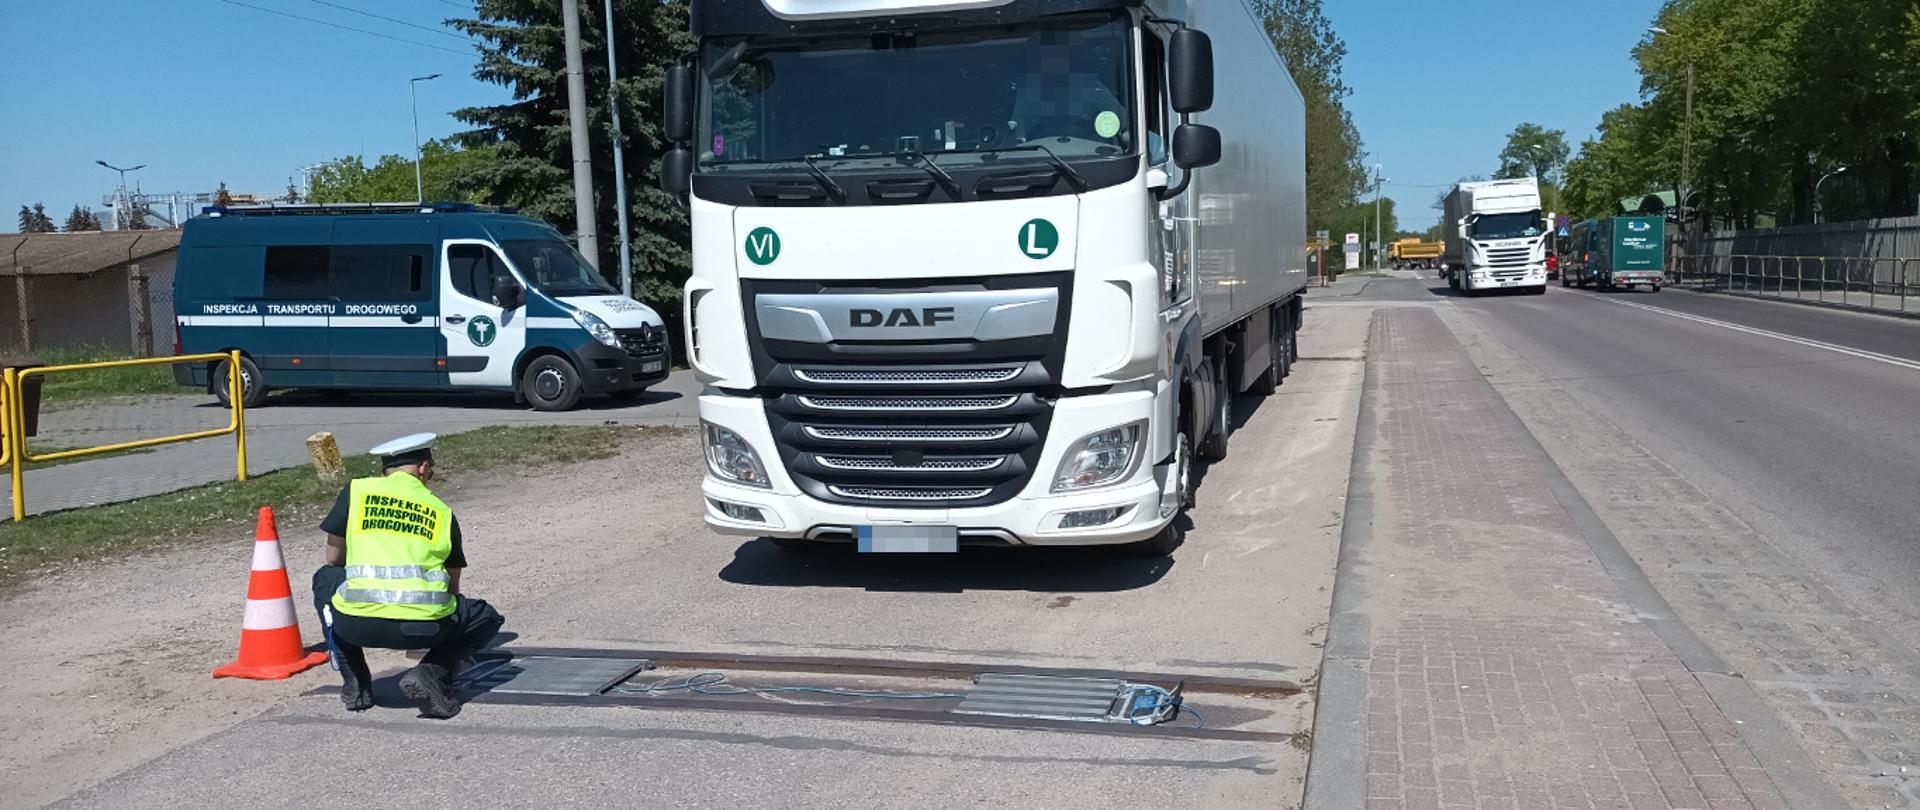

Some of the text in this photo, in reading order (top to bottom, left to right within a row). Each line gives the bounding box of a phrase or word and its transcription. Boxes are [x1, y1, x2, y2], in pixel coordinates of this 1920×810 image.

[750, 233, 774, 259] VI
[1026, 223, 1049, 255] L
[203, 304, 417, 315] INSPEKCJA TRANSPORTU DROGOWEGO
[849, 306, 955, 328] DAF
[364, 506, 436, 530] TRANSPORTU
[365, 494, 437, 520] INSPEKCJA
[362, 519, 433, 541] DROGOWEGO
